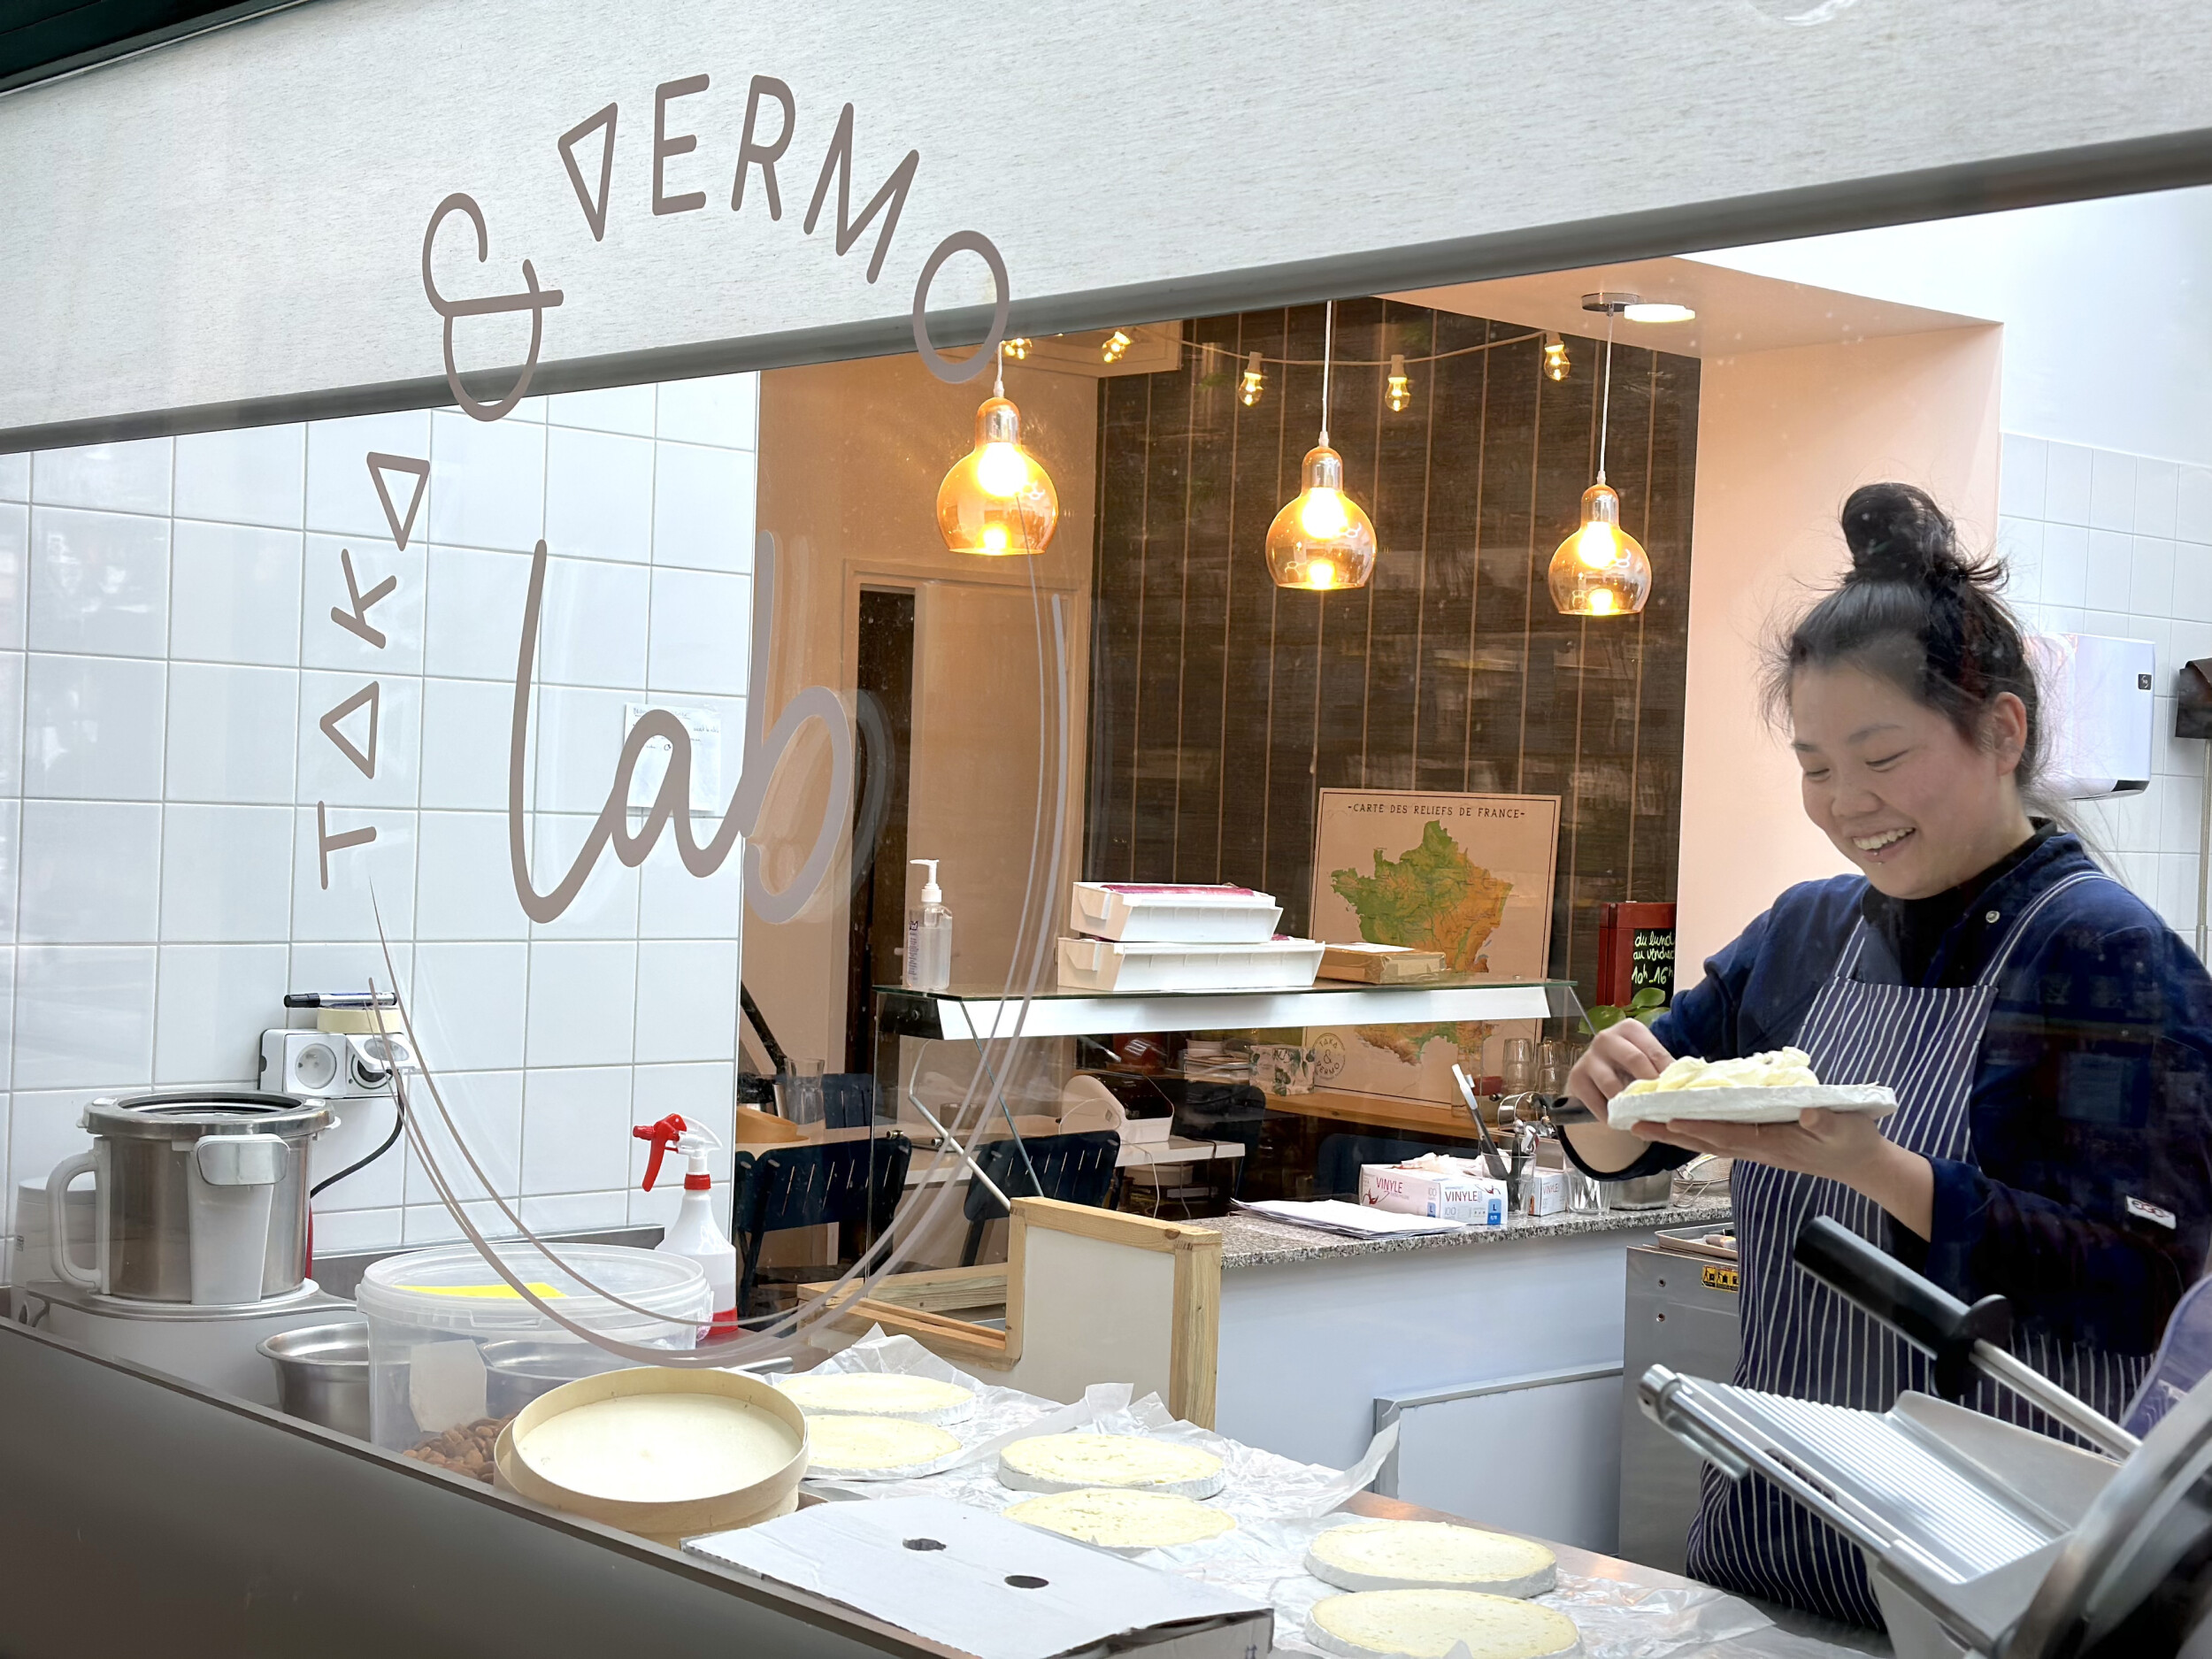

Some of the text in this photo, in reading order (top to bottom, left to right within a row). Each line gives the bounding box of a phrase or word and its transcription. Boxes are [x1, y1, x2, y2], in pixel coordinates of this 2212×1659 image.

[421, 191, 565, 423] &
[557, 73, 1011, 386] VERMO
[509, 529, 853, 925] lab
[1389, 804, 1409, 814] DES
[1413, 805, 1454, 816] RELIEFS
[1459, 807, 1472, 817] DE
[1635, 931, 1675, 947] du lund
[1632, 949, 1645, 961] au
[1323, 1049, 1332, 1064] &
[1317, 1061, 1340, 1074] VERMO
[1376, 1176, 1404, 1194] VINYLE
[1542, 1182, 1559, 1195] VINYLE
[1444, 1190, 1478, 1202] VINYLE
